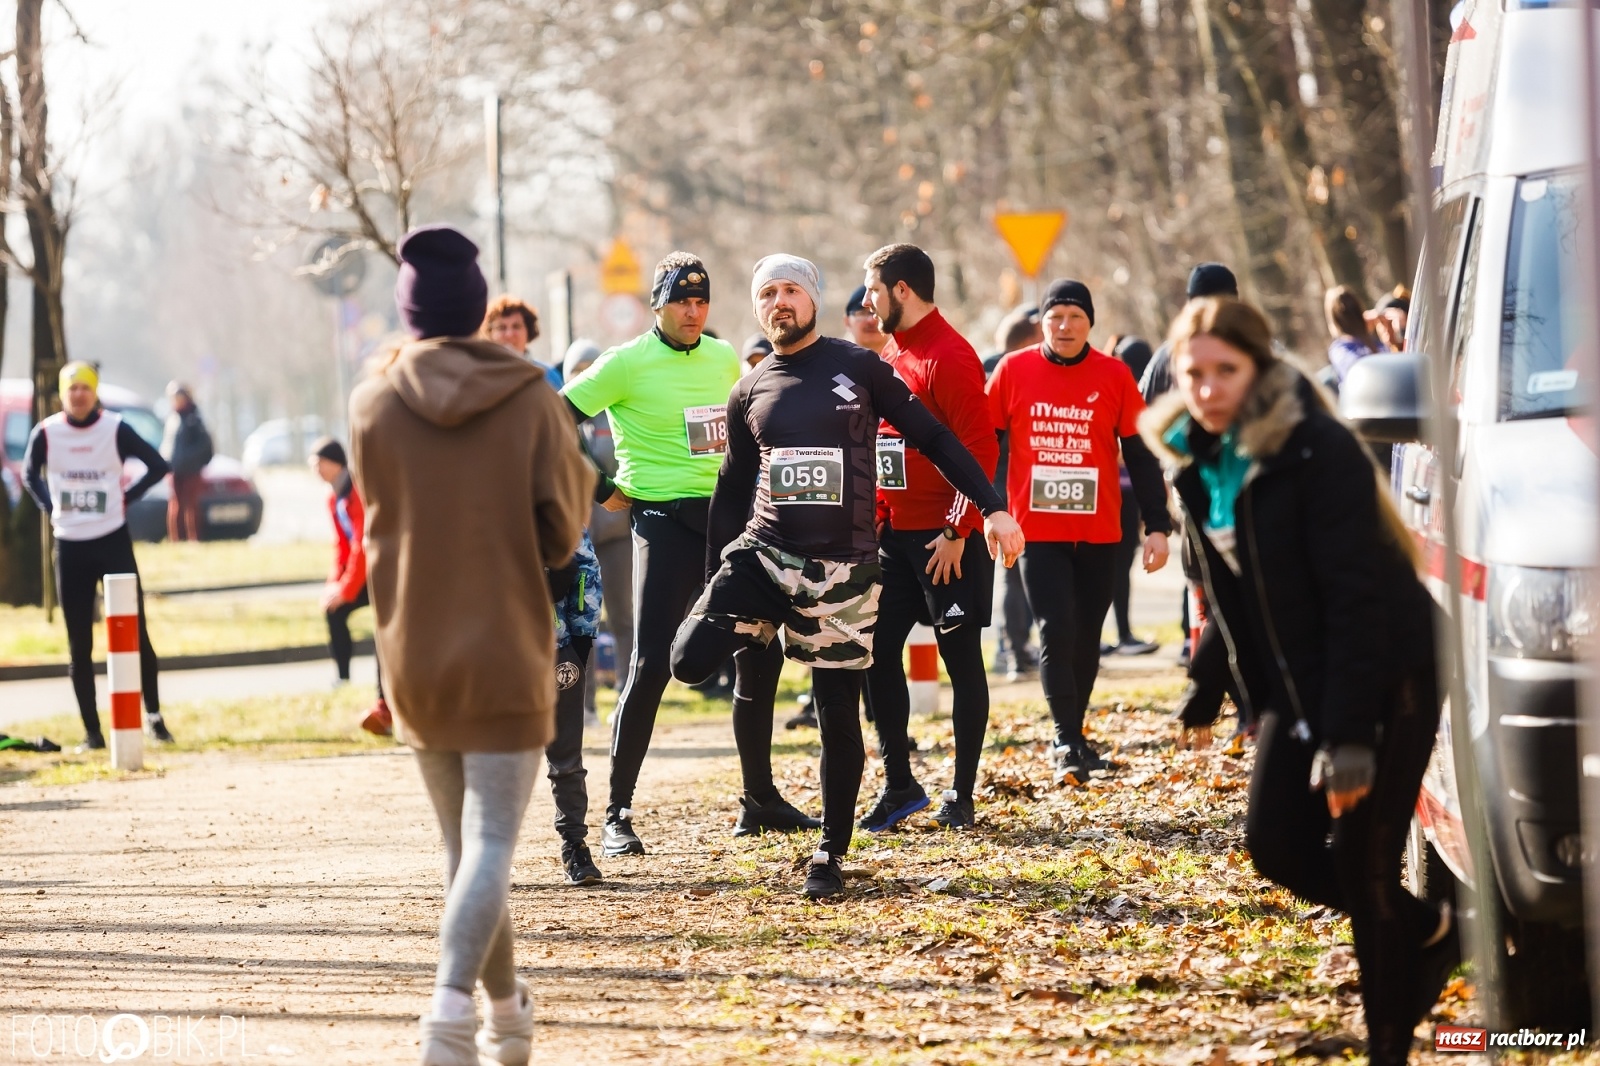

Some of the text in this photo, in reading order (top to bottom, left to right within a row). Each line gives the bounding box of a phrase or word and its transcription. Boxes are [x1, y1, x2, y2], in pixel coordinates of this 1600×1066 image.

[703, 421, 727, 441] 118
[781, 466, 827, 487] 059
[1044, 481, 1084, 501] 098
